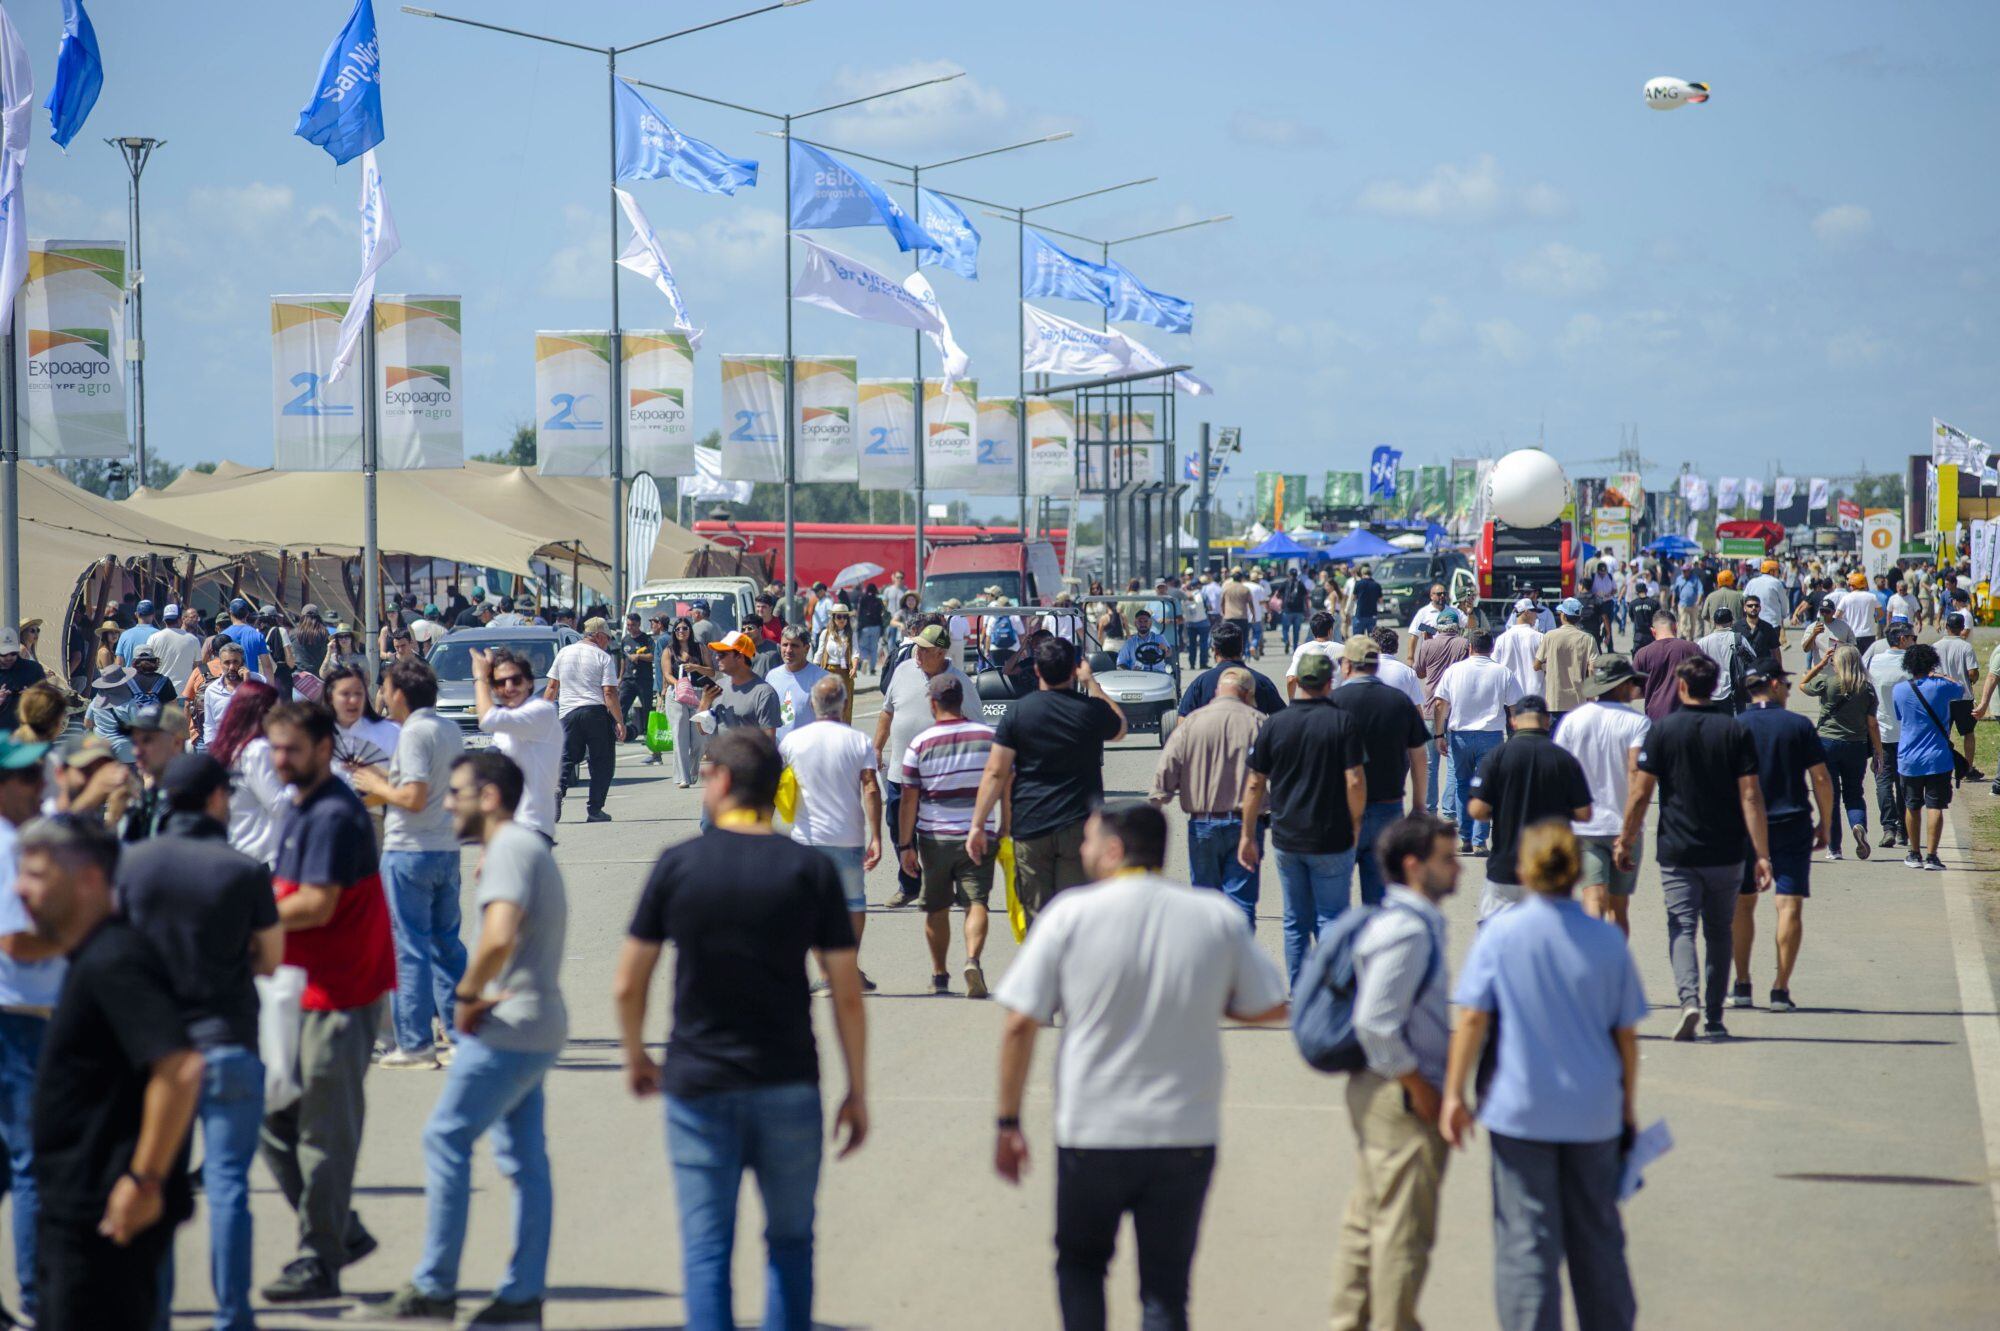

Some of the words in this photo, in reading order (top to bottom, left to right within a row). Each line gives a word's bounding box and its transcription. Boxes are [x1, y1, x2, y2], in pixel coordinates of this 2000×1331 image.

[320, 65, 372, 102] San
[1645, 87, 1679, 99] AMG
[28, 361, 110, 379] Expoagro
[78, 383, 111, 396] agro
[385, 391, 451, 406] Expoagro
[425, 409, 452, 420] agro
[630, 409, 685, 422] Expoagro
[663, 424, 685, 434] agro
[801, 424, 850, 436] Expoagro
[1514, 556, 1541, 564] YOMEL
